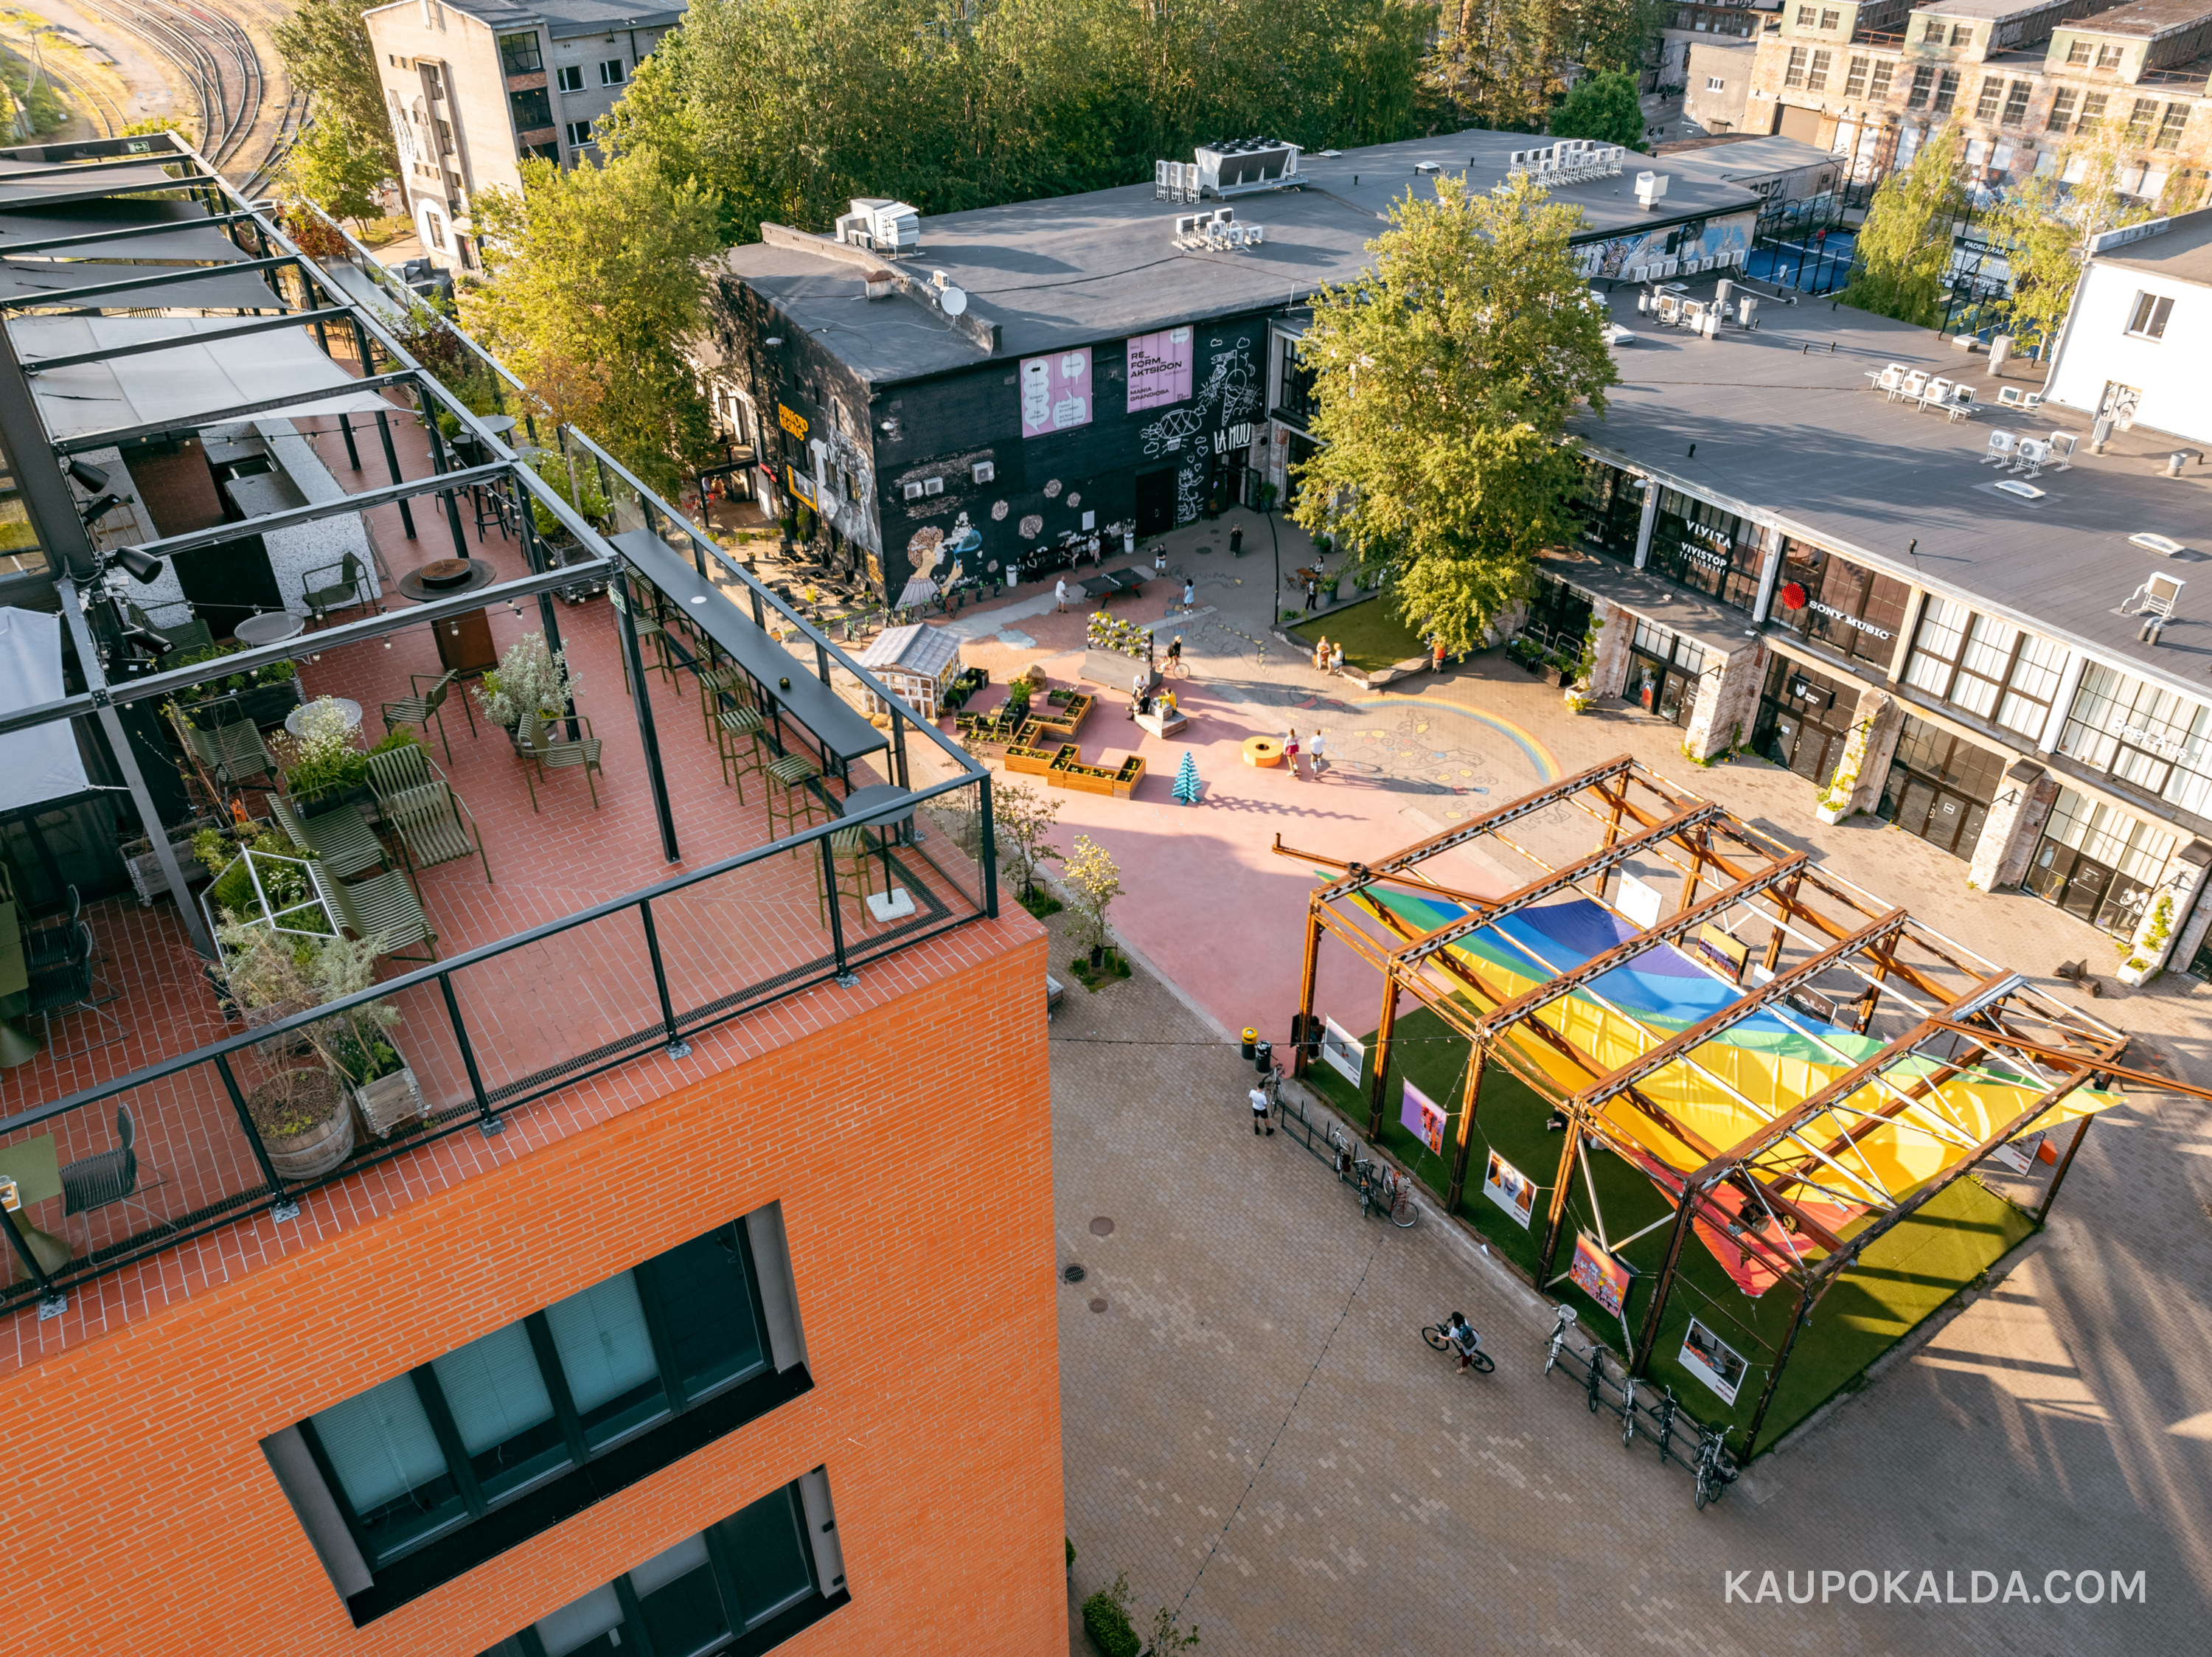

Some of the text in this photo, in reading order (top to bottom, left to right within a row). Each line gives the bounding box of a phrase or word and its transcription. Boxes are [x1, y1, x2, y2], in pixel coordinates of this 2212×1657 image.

[1130, 386, 1152, 396] MANIA
[1130, 389, 1169, 402] GRANDIOSA
[1214, 422, 1251, 454] LA MUU
[1686, 519, 1731, 549] VIVITA
[1679, 551, 1725, 576] TELLISKIVI
[1681, 542, 1727, 567] VIVISTOP
[1809, 600, 1890, 640] SONY MUSIC
[2110, 714, 2189, 759] Reet Aus
